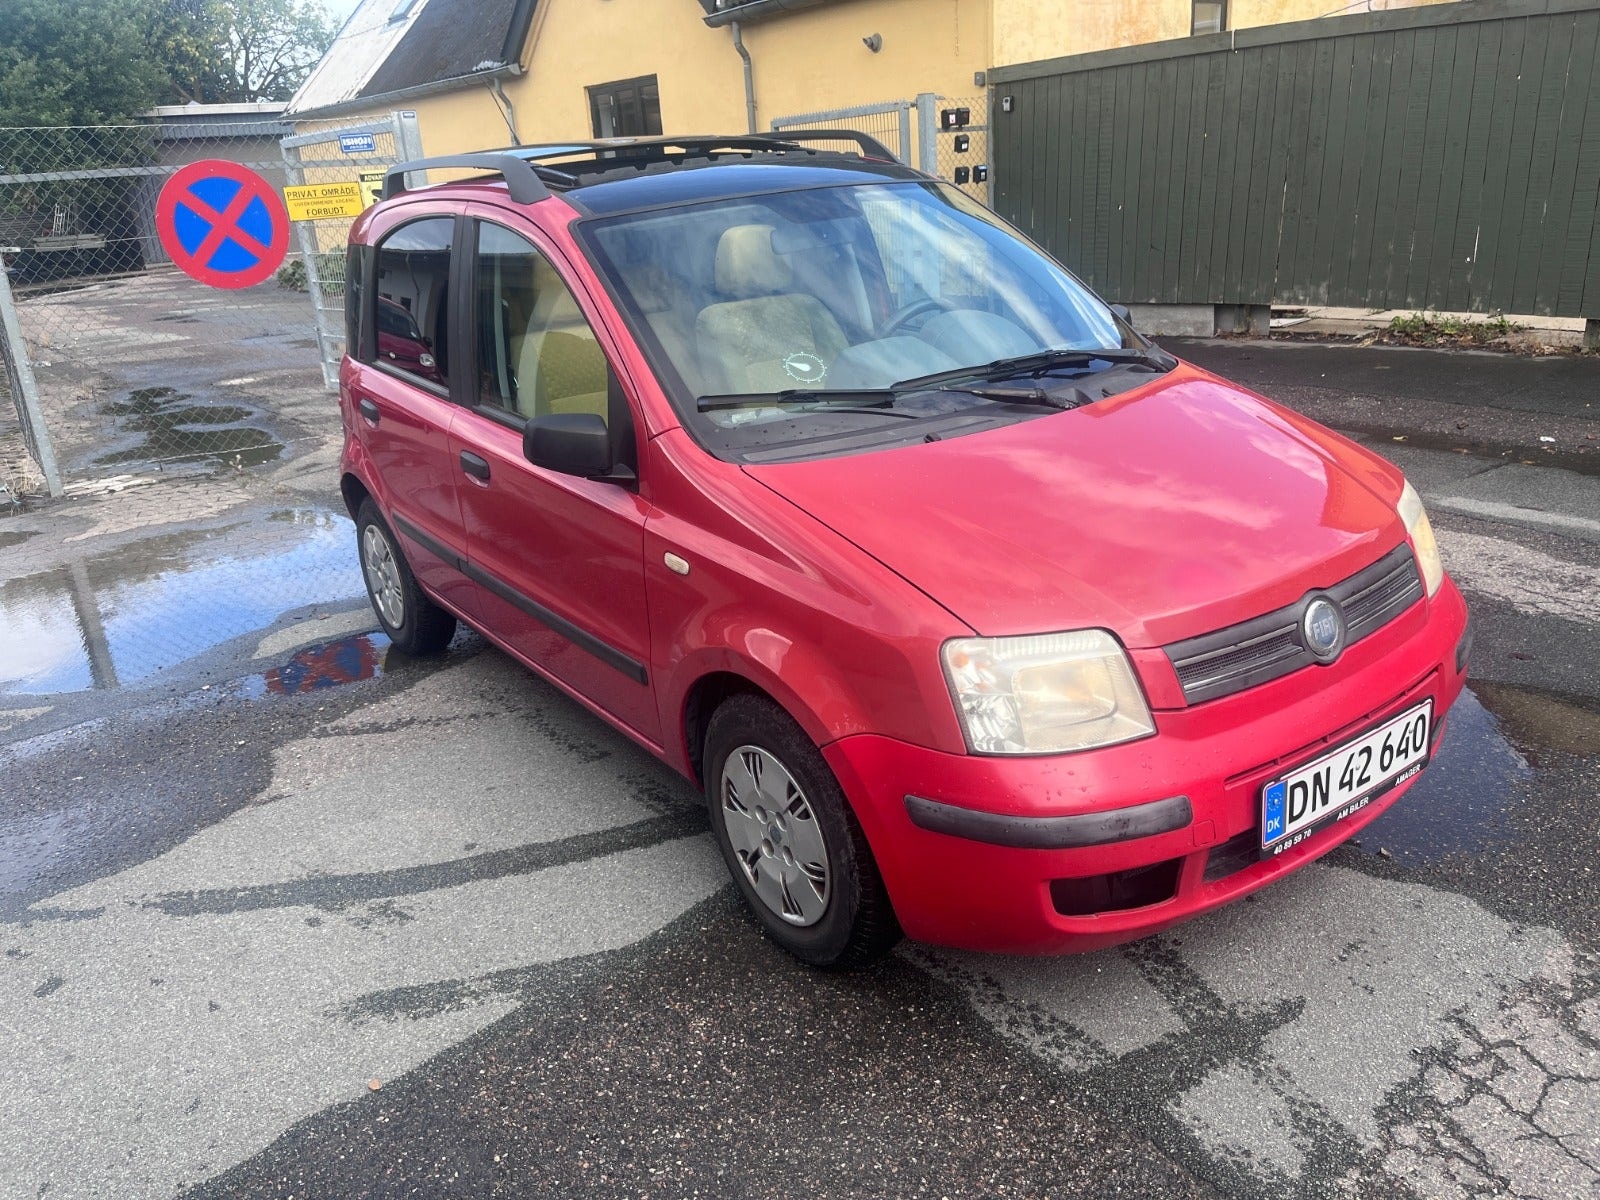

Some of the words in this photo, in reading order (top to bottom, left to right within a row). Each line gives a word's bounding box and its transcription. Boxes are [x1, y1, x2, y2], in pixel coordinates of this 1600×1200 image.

[286, 190, 317, 199] PRIVAT
[1312, 616, 1336, 640] FIAT
[1288, 766, 1331, 825] DN
[1338, 745, 1372, 793] 42
[1379, 713, 1427, 773] 640
[1394, 764, 1421, 786] AMAGER
[1337, 808, 1350, 821] AM
[1349, 797, 1369, 815] BILER
[1267, 816, 1281, 833] DK
[1303, 829, 1312, 840] 70
